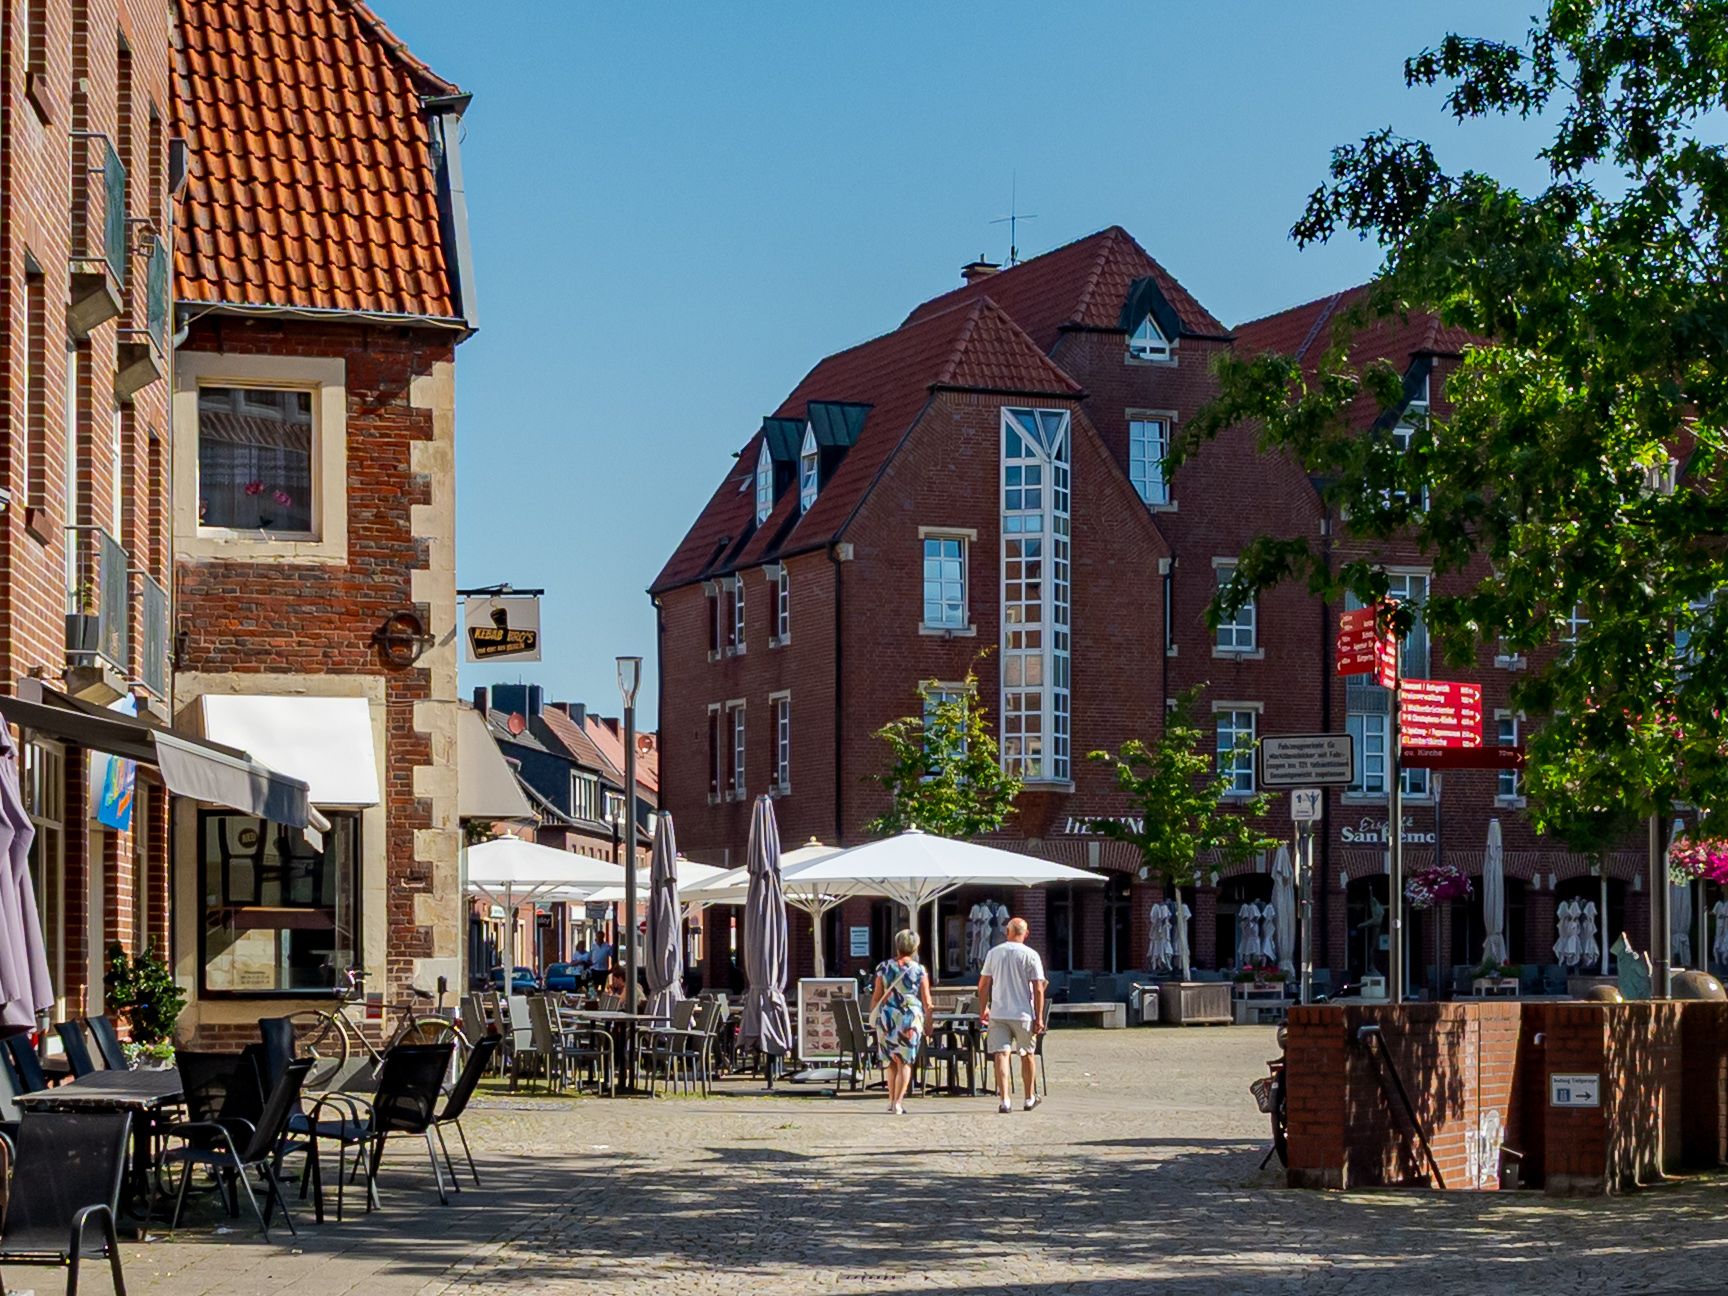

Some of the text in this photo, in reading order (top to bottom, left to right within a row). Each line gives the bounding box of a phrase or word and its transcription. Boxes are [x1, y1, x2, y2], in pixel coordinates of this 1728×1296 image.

[475, 629, 504, 641] KEBAB
[1417, 748, 1443, 757] Kirche
[1341, 826, 1378, 843] San
